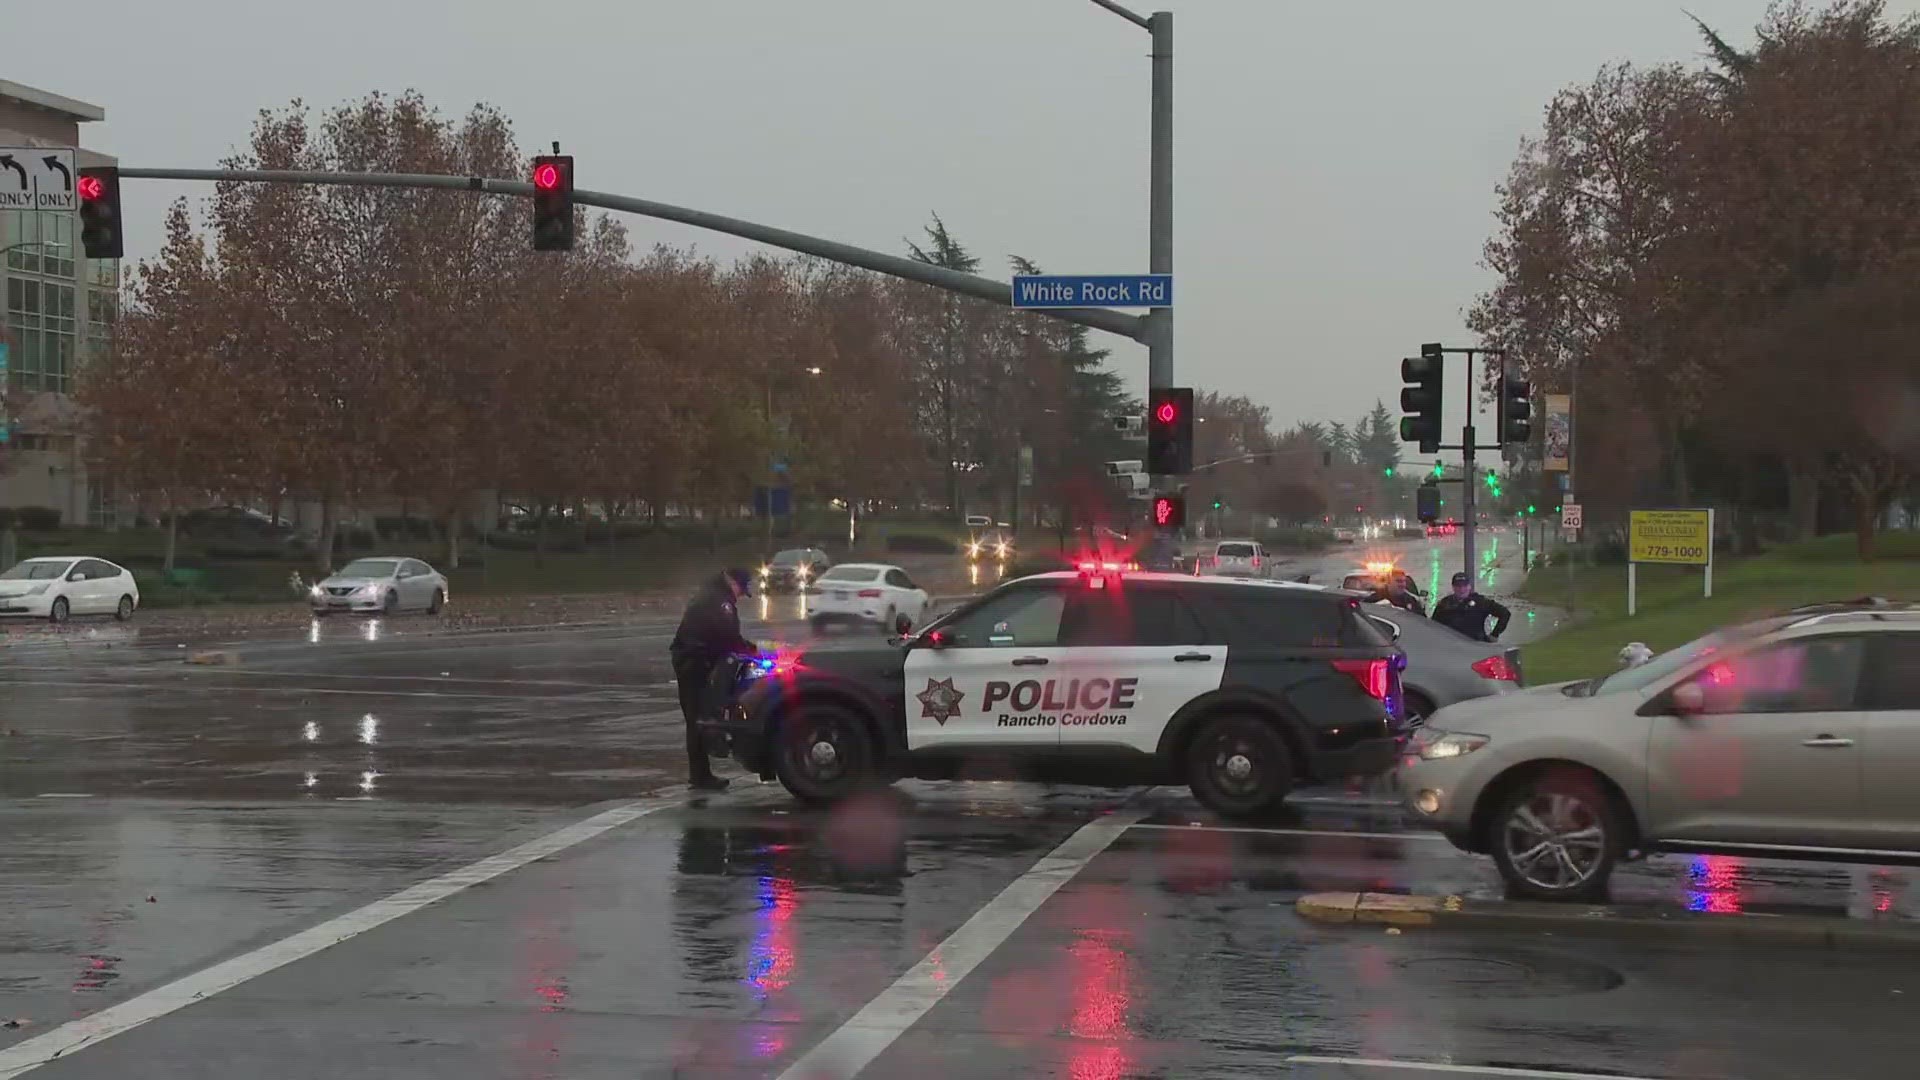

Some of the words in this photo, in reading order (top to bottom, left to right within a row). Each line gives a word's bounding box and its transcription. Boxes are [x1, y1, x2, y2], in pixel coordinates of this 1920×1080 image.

[0, 193, 32, 206] ONLY
[39, 193, 72, 207] ONLY
[1021, 282, 1074, 301] White
[1082, 282, 1131, 300] Rock
[1139, 281, 1165, 300] Rd
[1563, 516, 1580, 526] 40
[1647, 545, 1703, 557] 779-1000
[981, 677, 1139, 712] POLICE
[997, 713, 1056, 727] Rancho
[1061, 712, 1127, 726] Cordova
